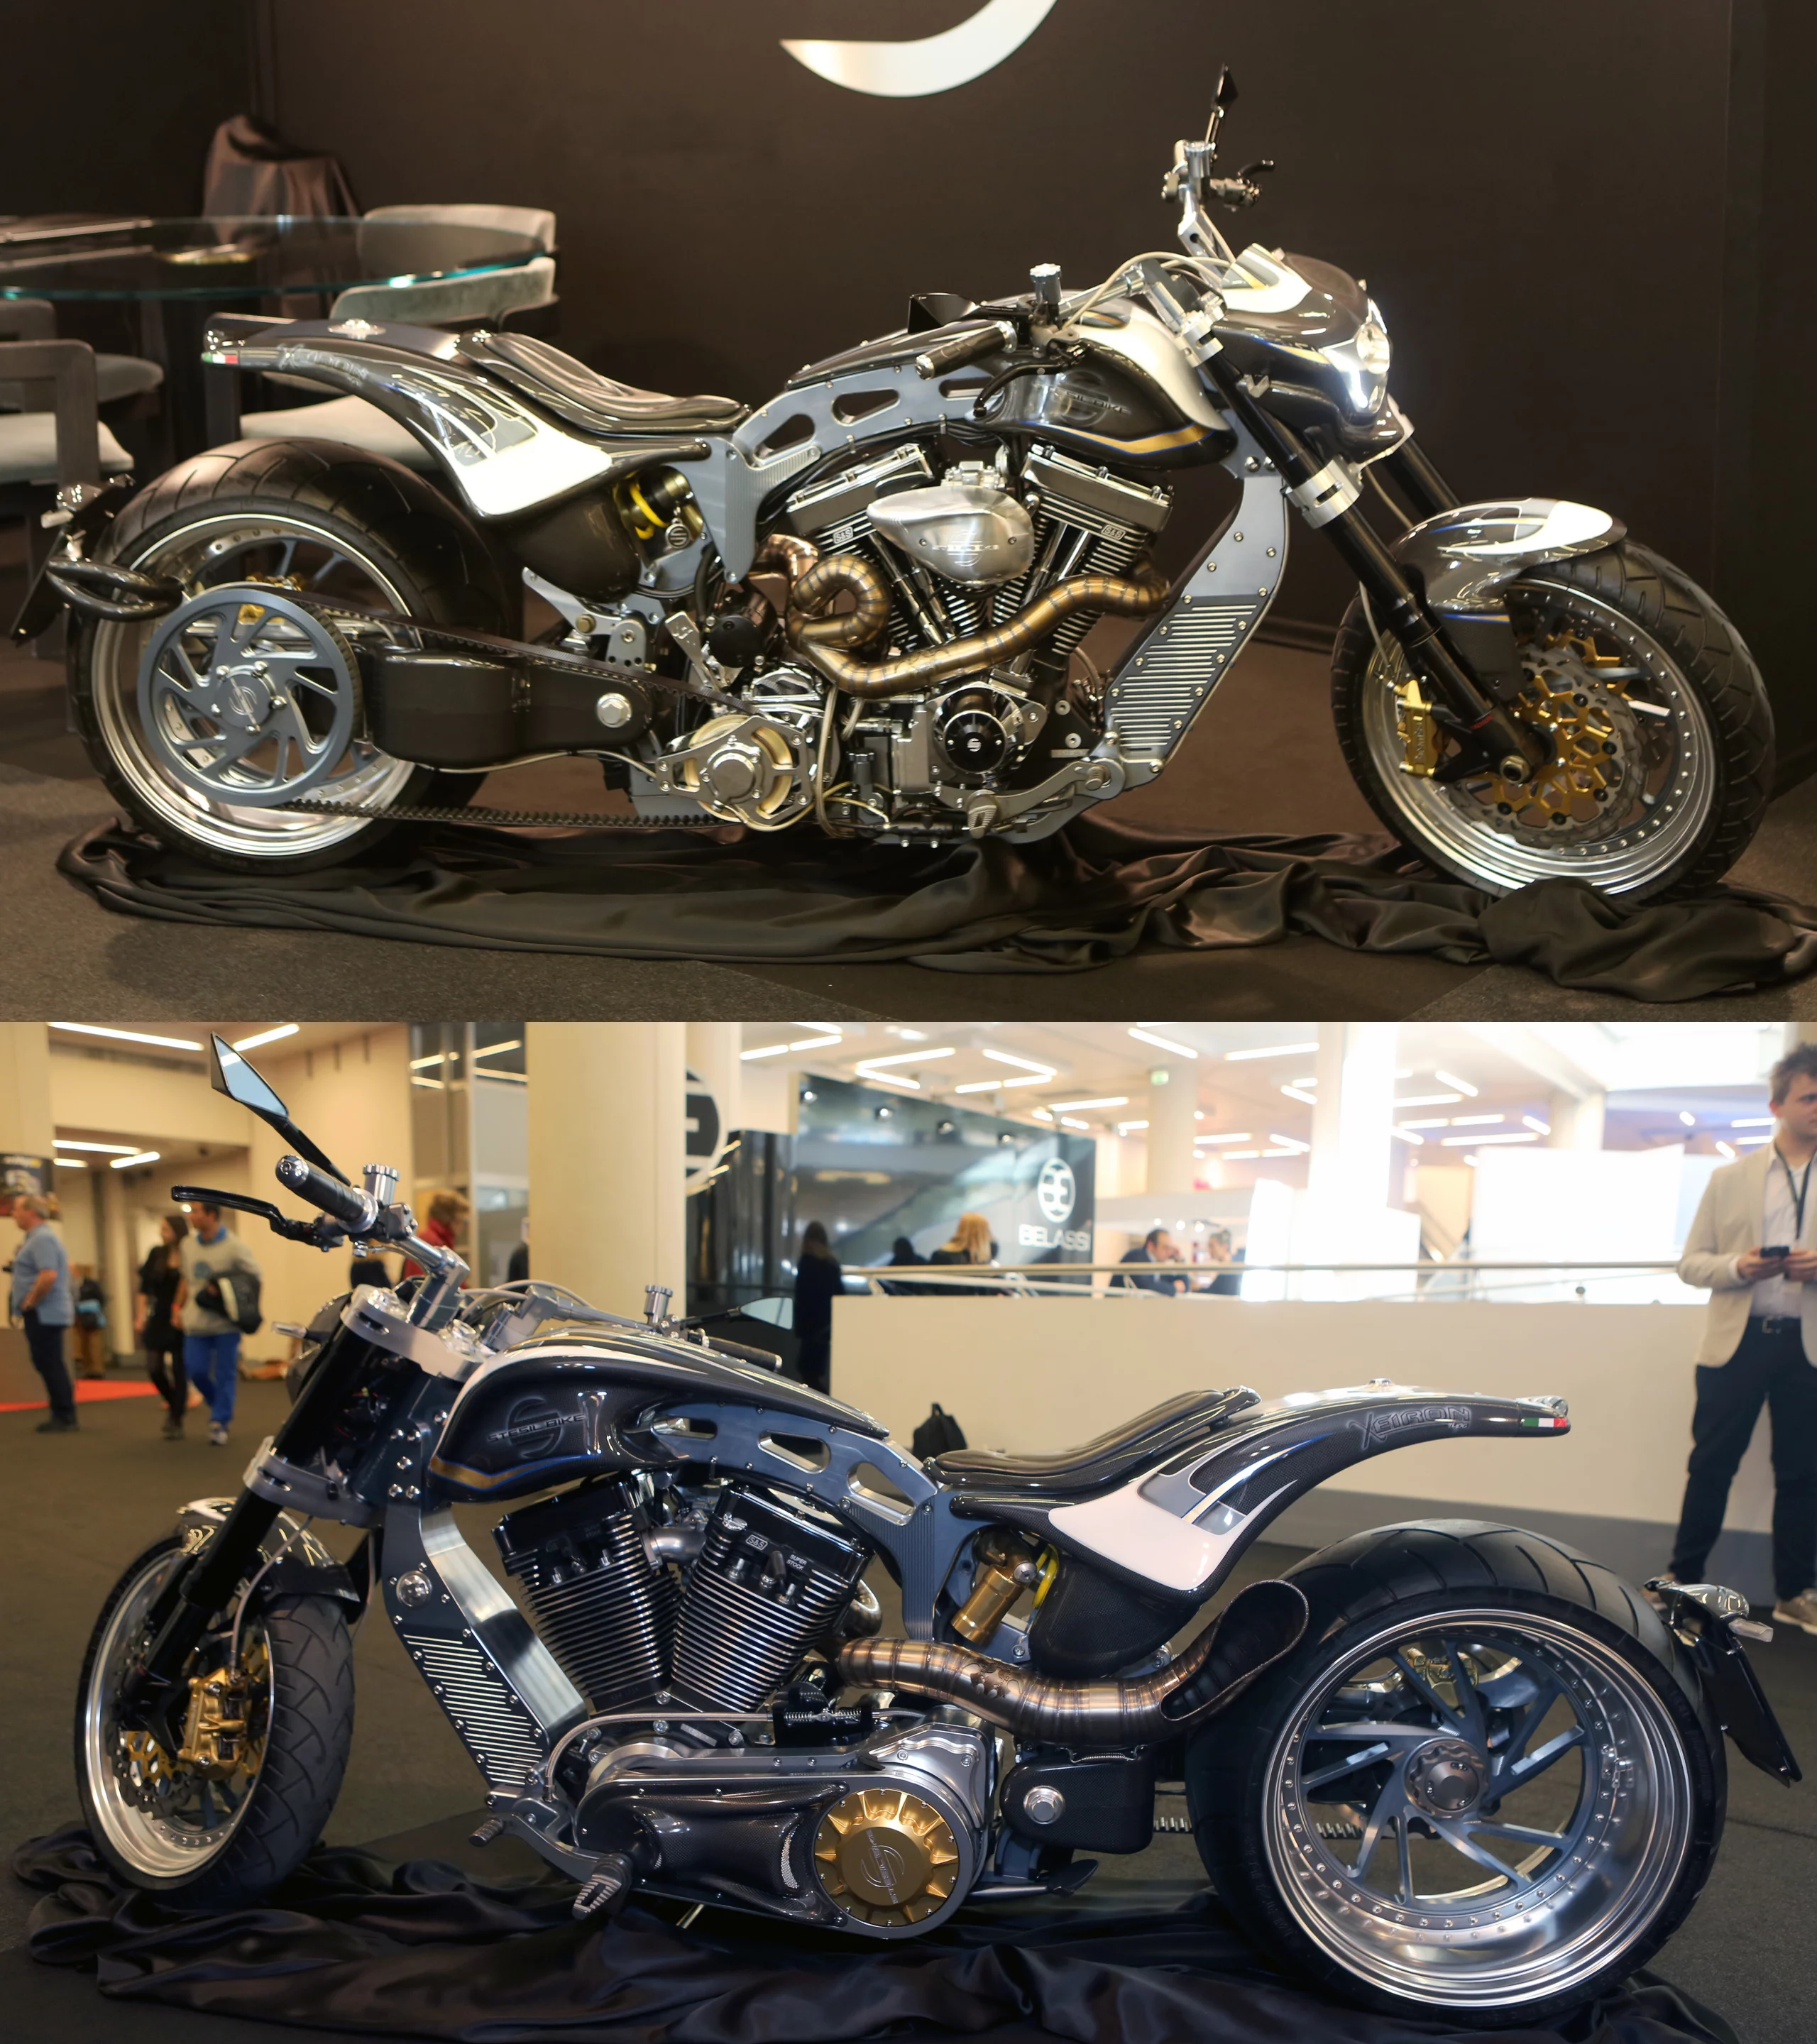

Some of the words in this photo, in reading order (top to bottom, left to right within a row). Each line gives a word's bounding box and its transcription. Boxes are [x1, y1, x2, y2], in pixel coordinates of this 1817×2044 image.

[835, 529, 852, 542] S&S
[487, 1424, 542, 1443] STESIL
[546, 1414, 587, 1429] BIKE
[1347, 1407, 1471, 1449] XEIRON
[748, 1537, 766, 1549] S&S
[786, 1559, 804, 1571] STOCK
[789, 1554, 808, 1566] SUPER
